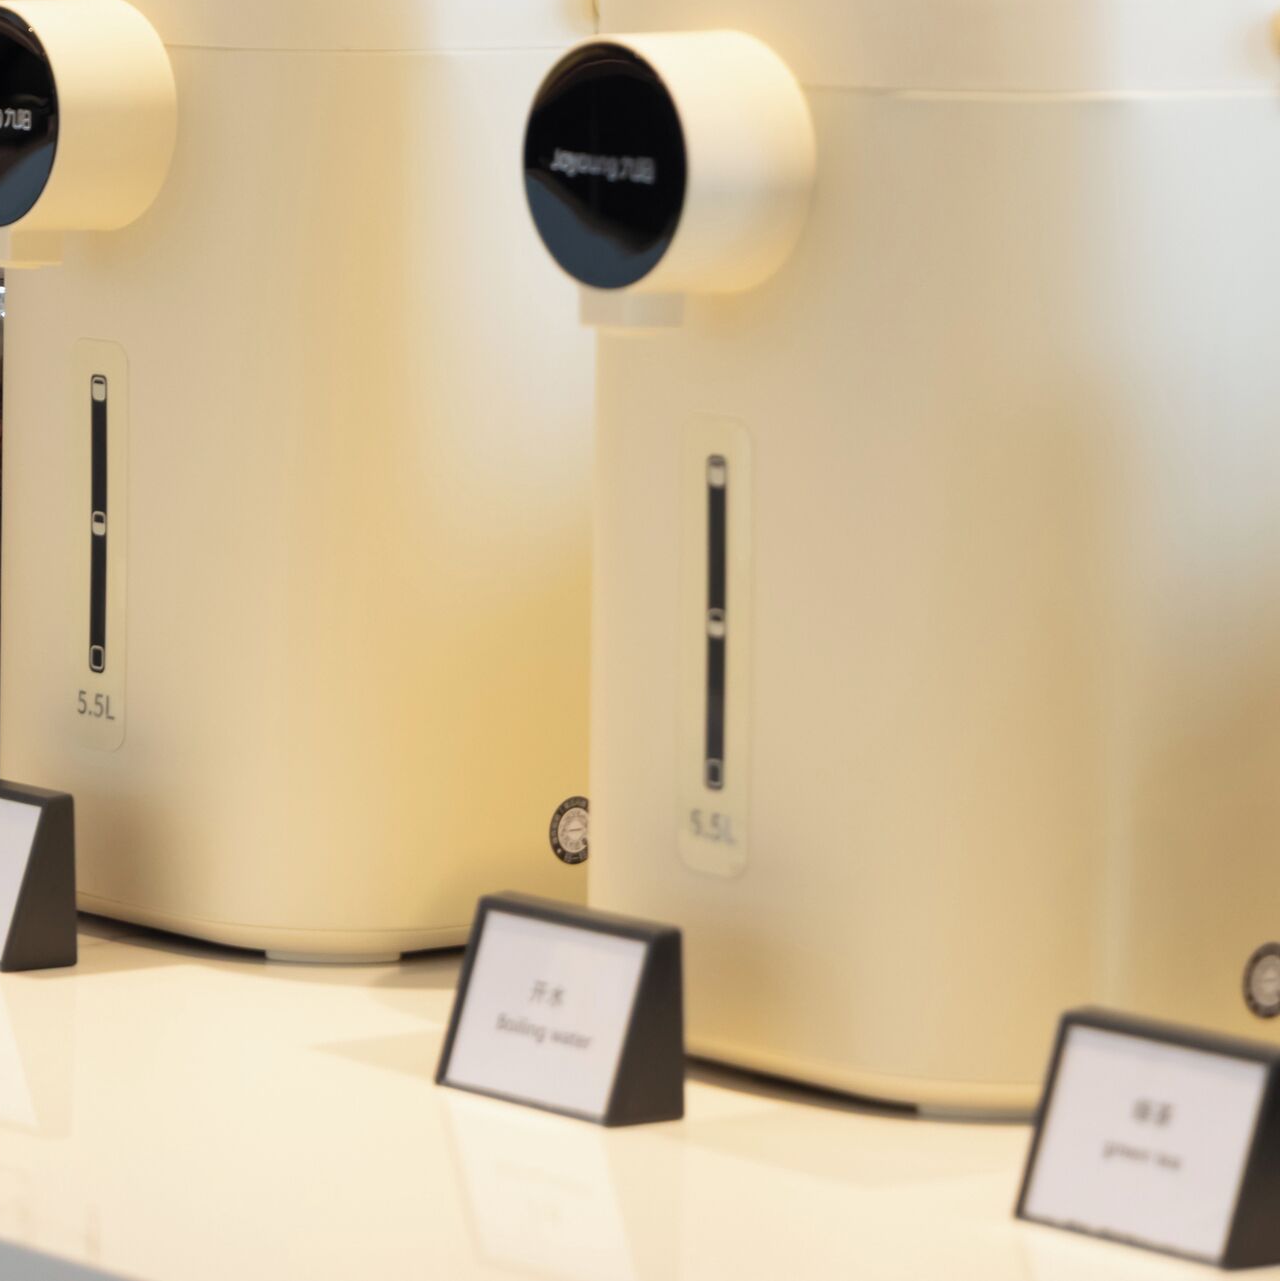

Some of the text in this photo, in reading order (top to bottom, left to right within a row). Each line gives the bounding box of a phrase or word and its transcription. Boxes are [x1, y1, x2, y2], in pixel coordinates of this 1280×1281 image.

[549, 147, 618, 183] Joyoung
[77, 689, 115, 721] 5.5L
[495, 1012, 592, 1049] Boiling water
